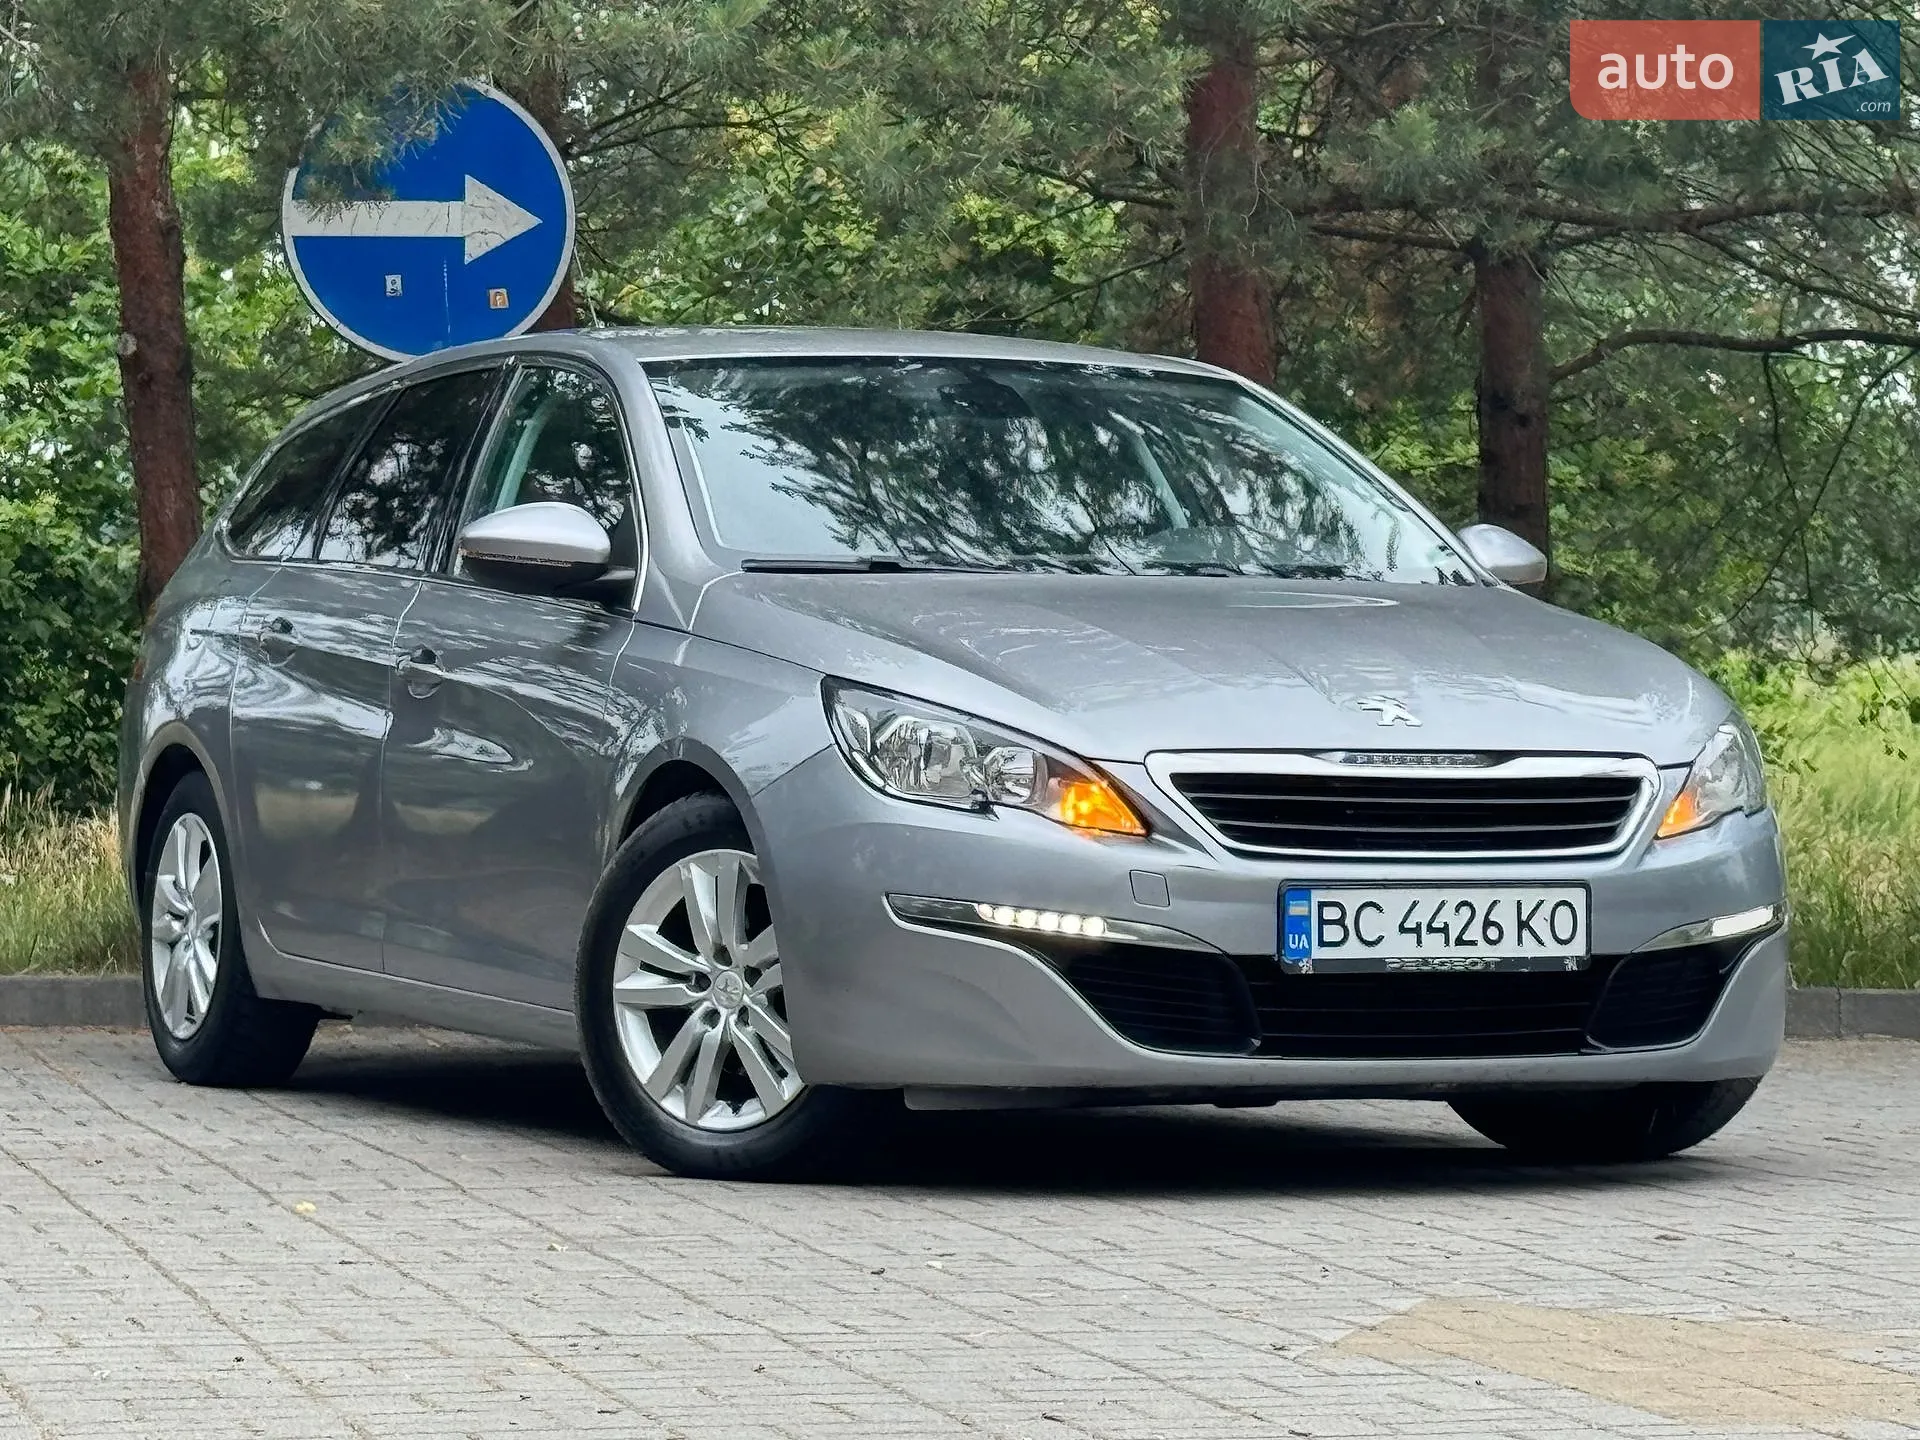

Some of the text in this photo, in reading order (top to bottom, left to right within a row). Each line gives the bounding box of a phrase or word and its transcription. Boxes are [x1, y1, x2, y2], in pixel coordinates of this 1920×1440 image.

[1317, 899, 1579, 948] BC 4426 KO
[1288, 932, 1310, 950] UA
